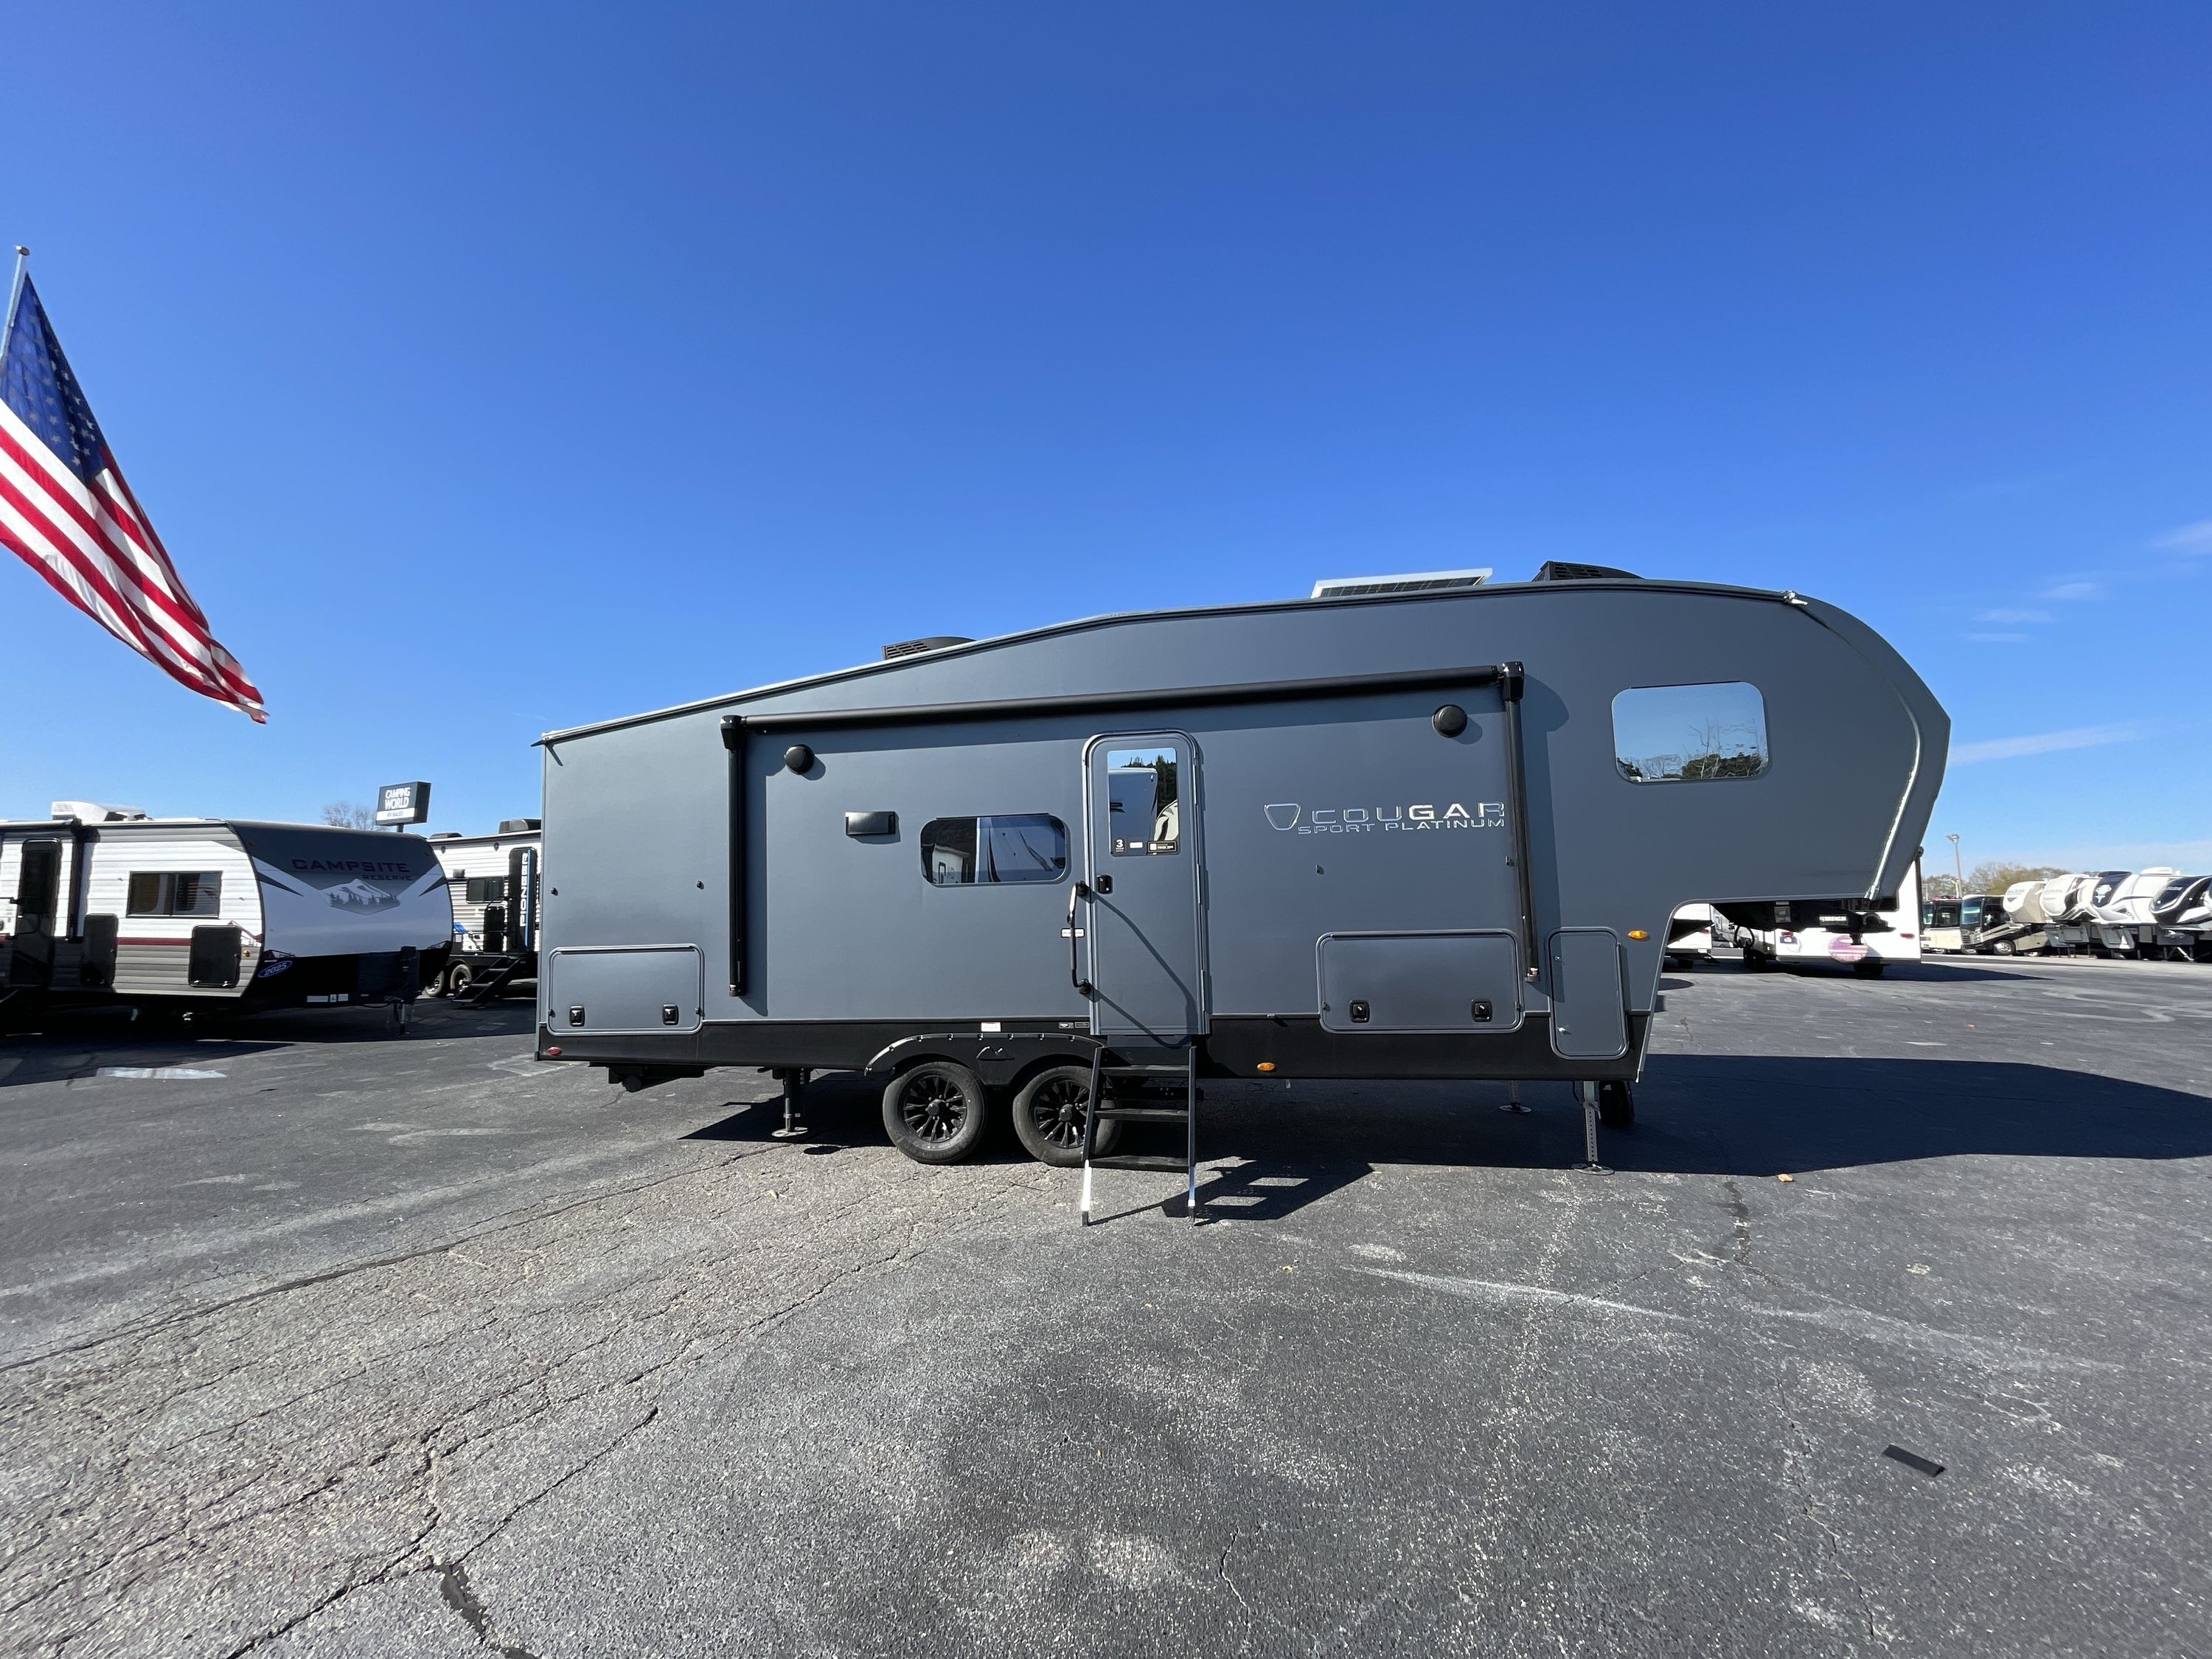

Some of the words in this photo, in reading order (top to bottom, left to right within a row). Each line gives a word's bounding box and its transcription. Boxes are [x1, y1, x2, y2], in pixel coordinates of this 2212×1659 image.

[385, 787, 411, 799] CAMPING
[385, 797, 409, 810] WORLD
[1312, 801, 1505, 824] COUGAR
[1298, 823, 1375, 835] SPORT
[1385, 818, 1505, 831] PLATINUM
[1116, 839, 1124, 848] 3
[291, 859, 410, 872] CAMPSITE
[520, 852, 529, 927] PIONEER
[265, 961, 287, 976] 2025
